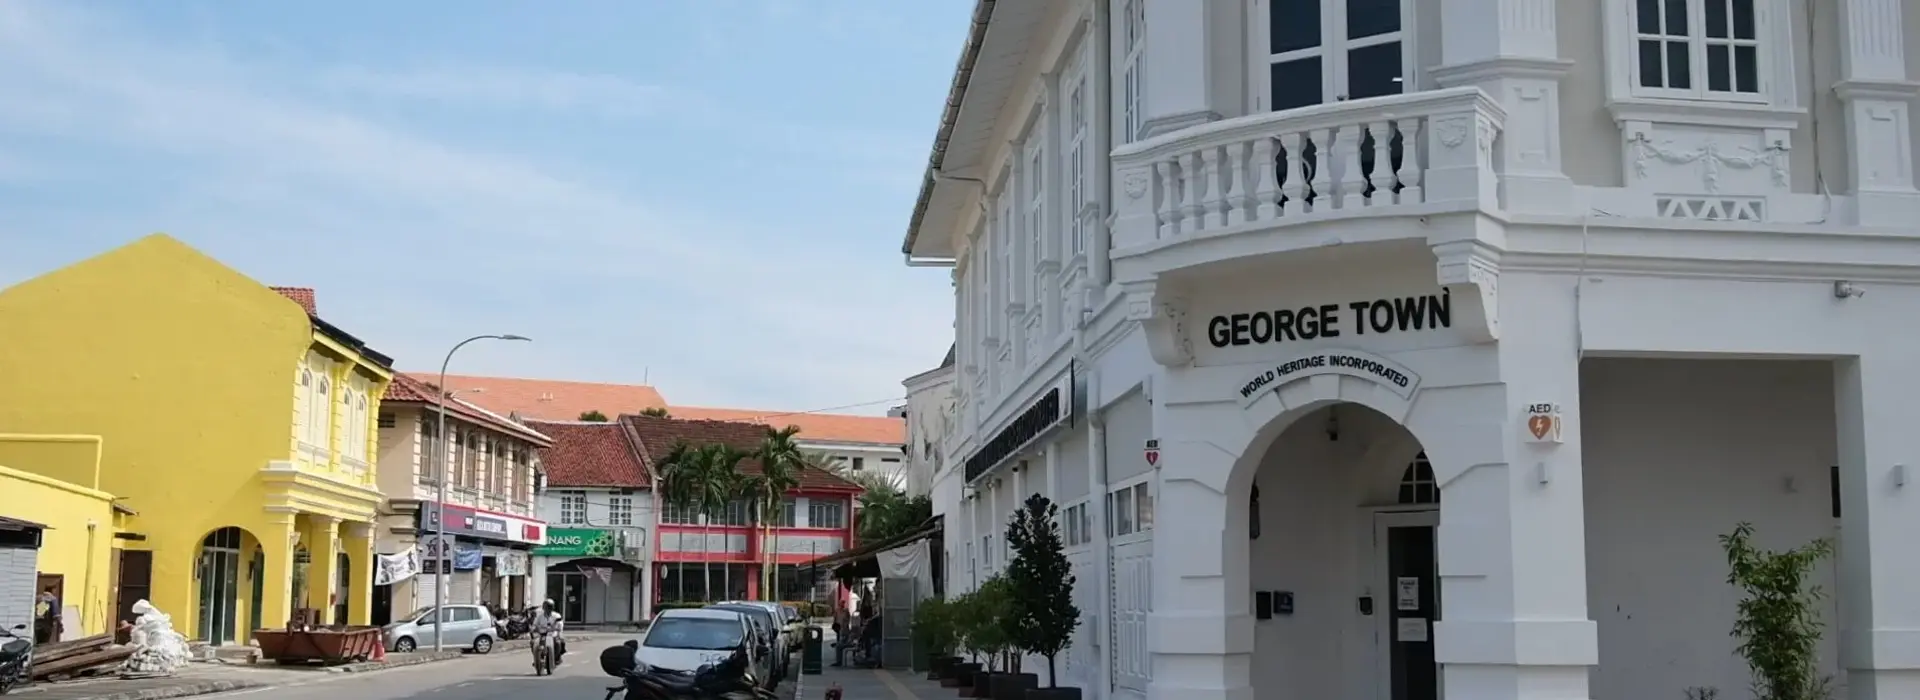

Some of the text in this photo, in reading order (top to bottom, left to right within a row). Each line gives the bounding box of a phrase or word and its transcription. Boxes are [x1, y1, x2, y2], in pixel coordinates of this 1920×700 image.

[1208, 293, 1450, 348] GEORGE TOWN
[1240, 355, 1409, 398] WORLD HERITAGE INCORPORATED
[1528, 403, 1551, 414] AED
[546, 535, 581, 545] NANG
